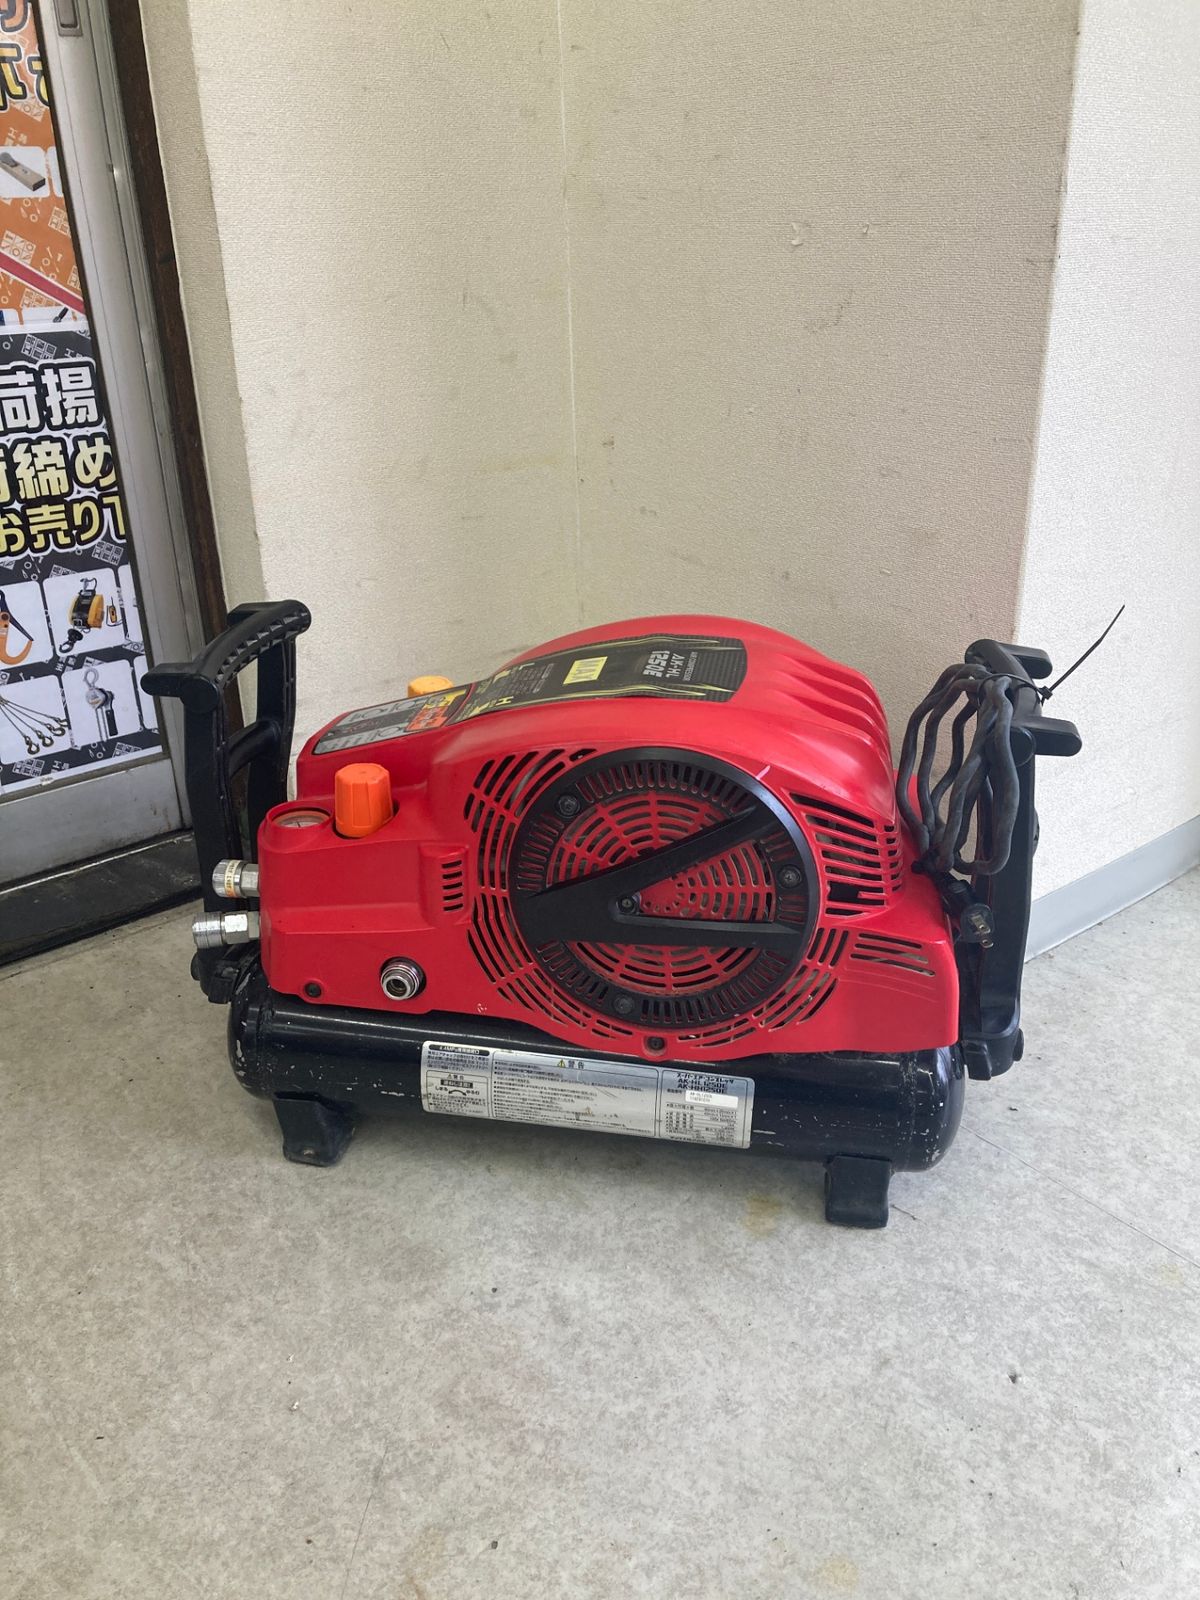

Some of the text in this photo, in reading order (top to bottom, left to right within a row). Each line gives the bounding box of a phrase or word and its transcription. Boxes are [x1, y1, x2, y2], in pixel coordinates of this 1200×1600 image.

[0, 437, 117, 501] 締め
[567, 658, 604, 682] MAX
[643, 650, 671, 678] 1250E
[665, 653, 686, 678] AK-HL
